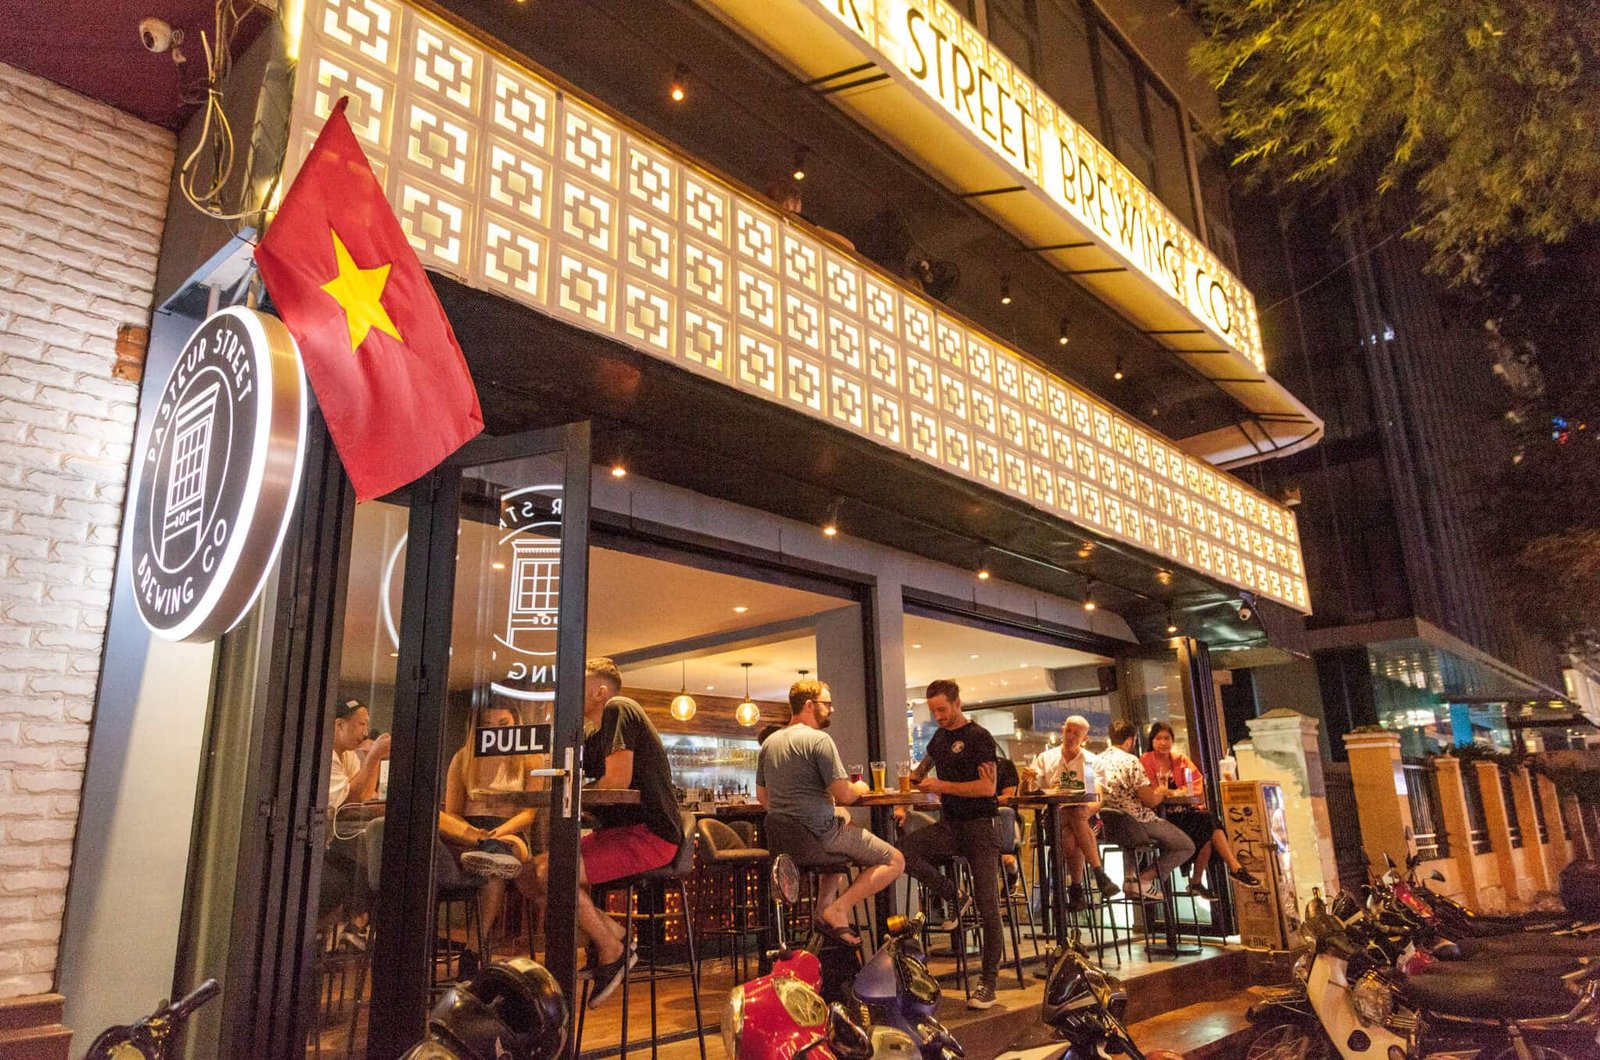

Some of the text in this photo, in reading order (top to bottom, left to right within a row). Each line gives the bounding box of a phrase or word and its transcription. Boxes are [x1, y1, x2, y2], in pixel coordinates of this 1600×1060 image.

[906, 7, 1231, 335] STREET BREWING CO
[148, 328, 252, 463] PASTEUR STREET
[137, 518, 227, 616] BREWING CO
[481, 727, 544, 753] PULL
